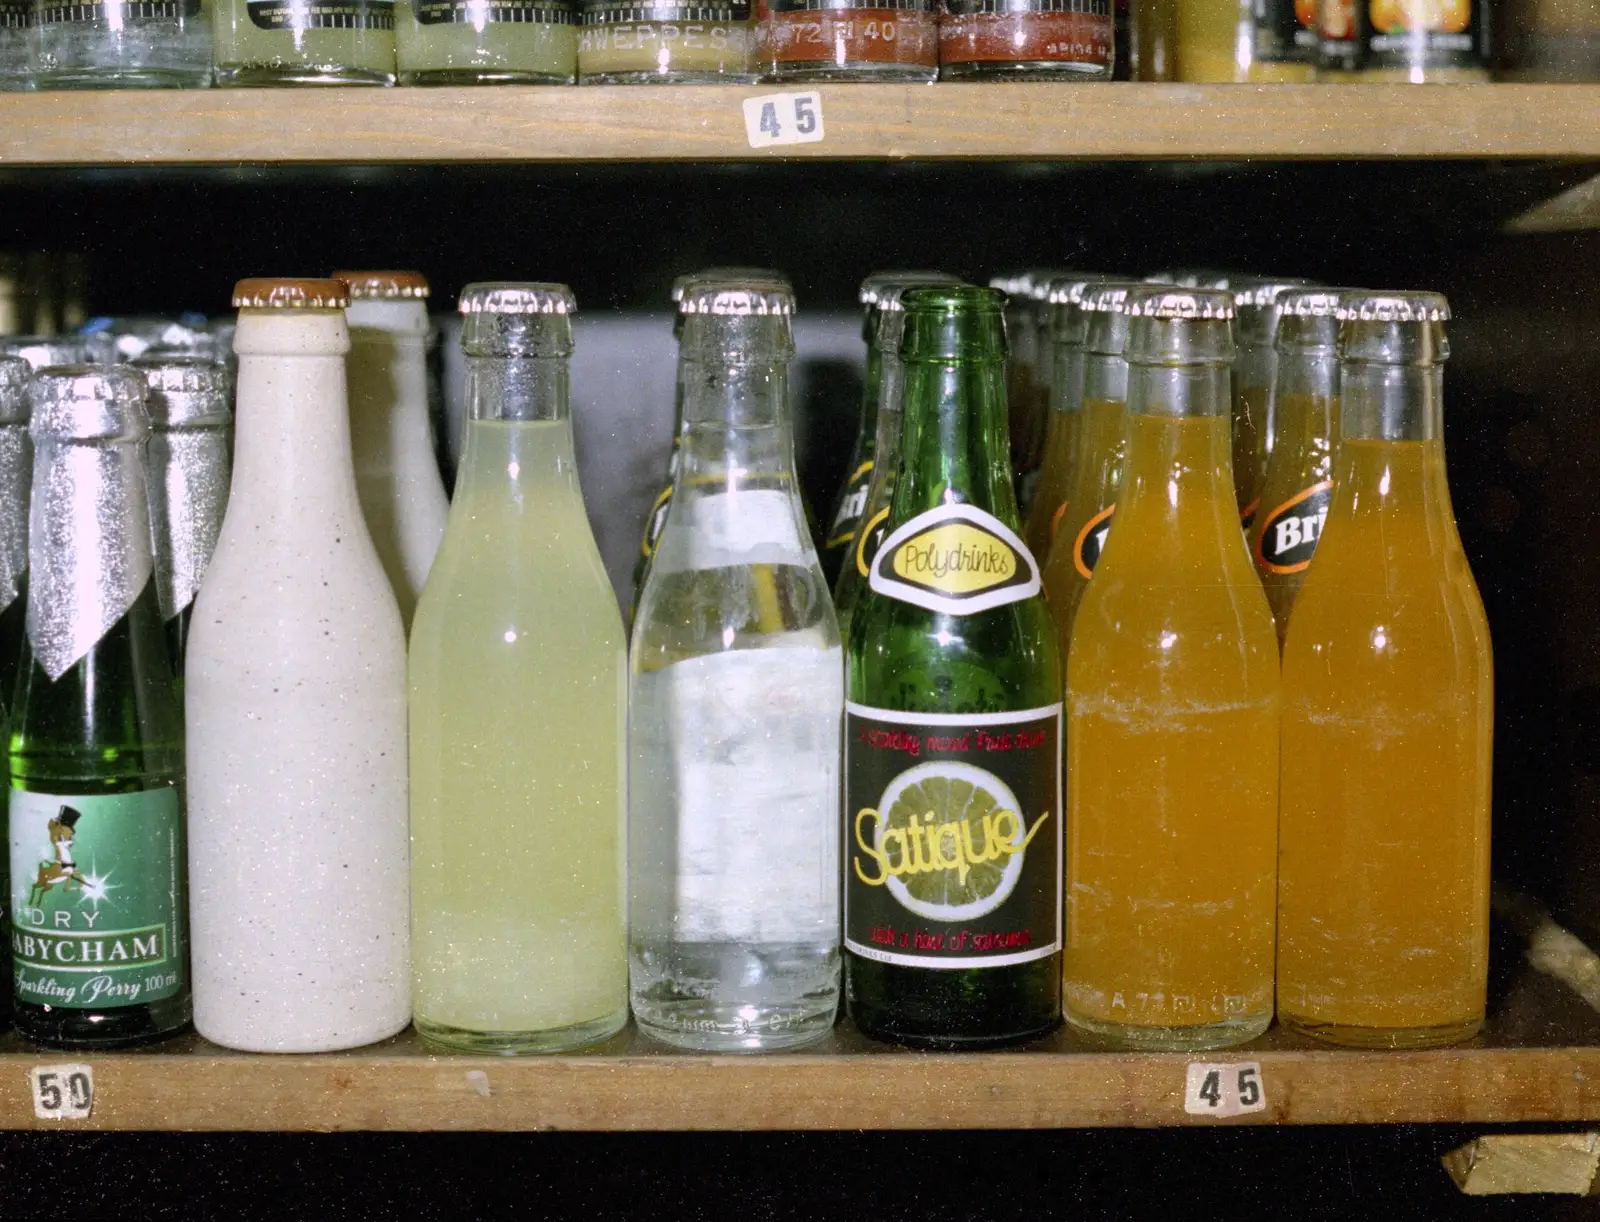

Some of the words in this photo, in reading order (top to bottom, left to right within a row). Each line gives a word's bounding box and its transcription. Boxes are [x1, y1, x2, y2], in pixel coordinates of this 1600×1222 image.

[864, 22, 896, 41] 40
[760, 97, 816, 137] 45
[904, 543, 1009, 578] Polydrinks
[854, 808, 1049, 886] Satique
[31, 908, 101, 928] DRY
[13, 934, 158, 962] ABYCHAM
[949, 929, 969, 951] of
[81, 975, 141, 1003] Perry
[145, 977, 164, 992] 100
[38, 1072, 90, 1110] 50
[1200, 1068, 1260, 1107] 45
